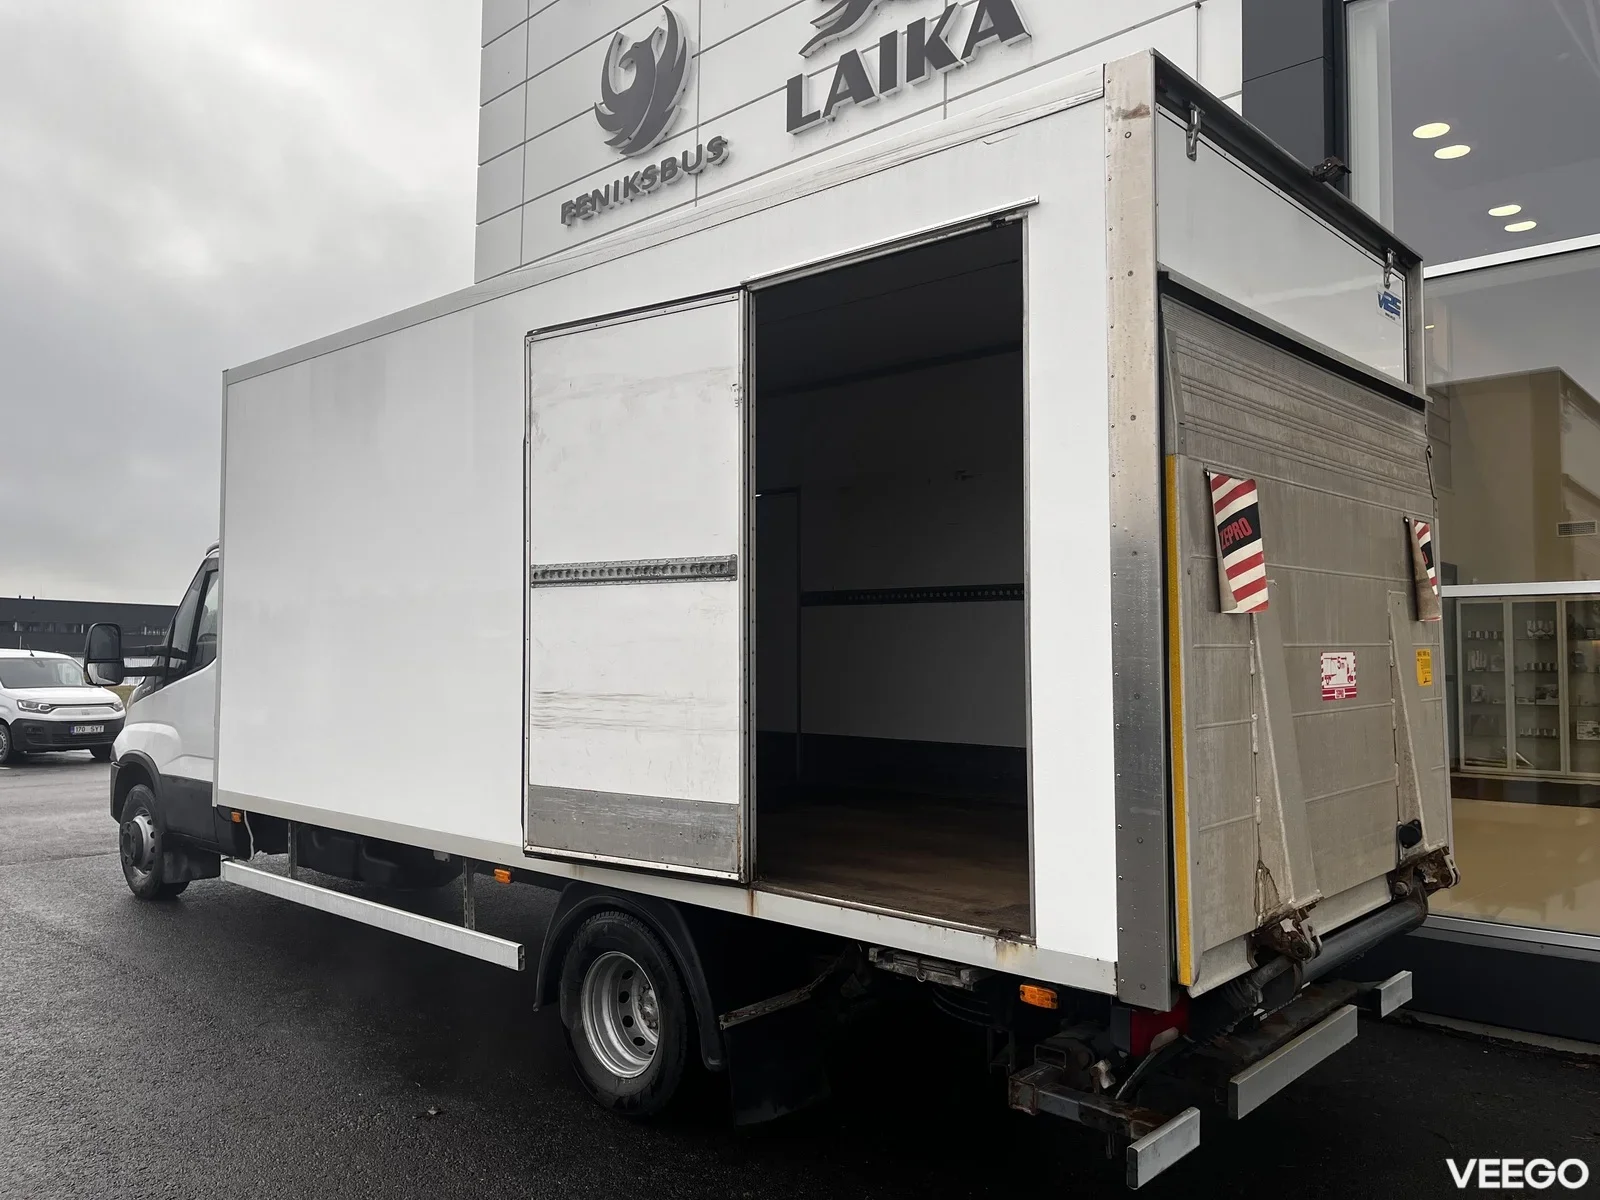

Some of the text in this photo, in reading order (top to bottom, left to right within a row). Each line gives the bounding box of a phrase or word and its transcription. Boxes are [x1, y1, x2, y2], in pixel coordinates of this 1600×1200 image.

[786, 0, 1032, 135] LAIKA
[560, 135, 730, 226] FENIKSBUS
[1218, 516, 1253, 550] ZEPRO
